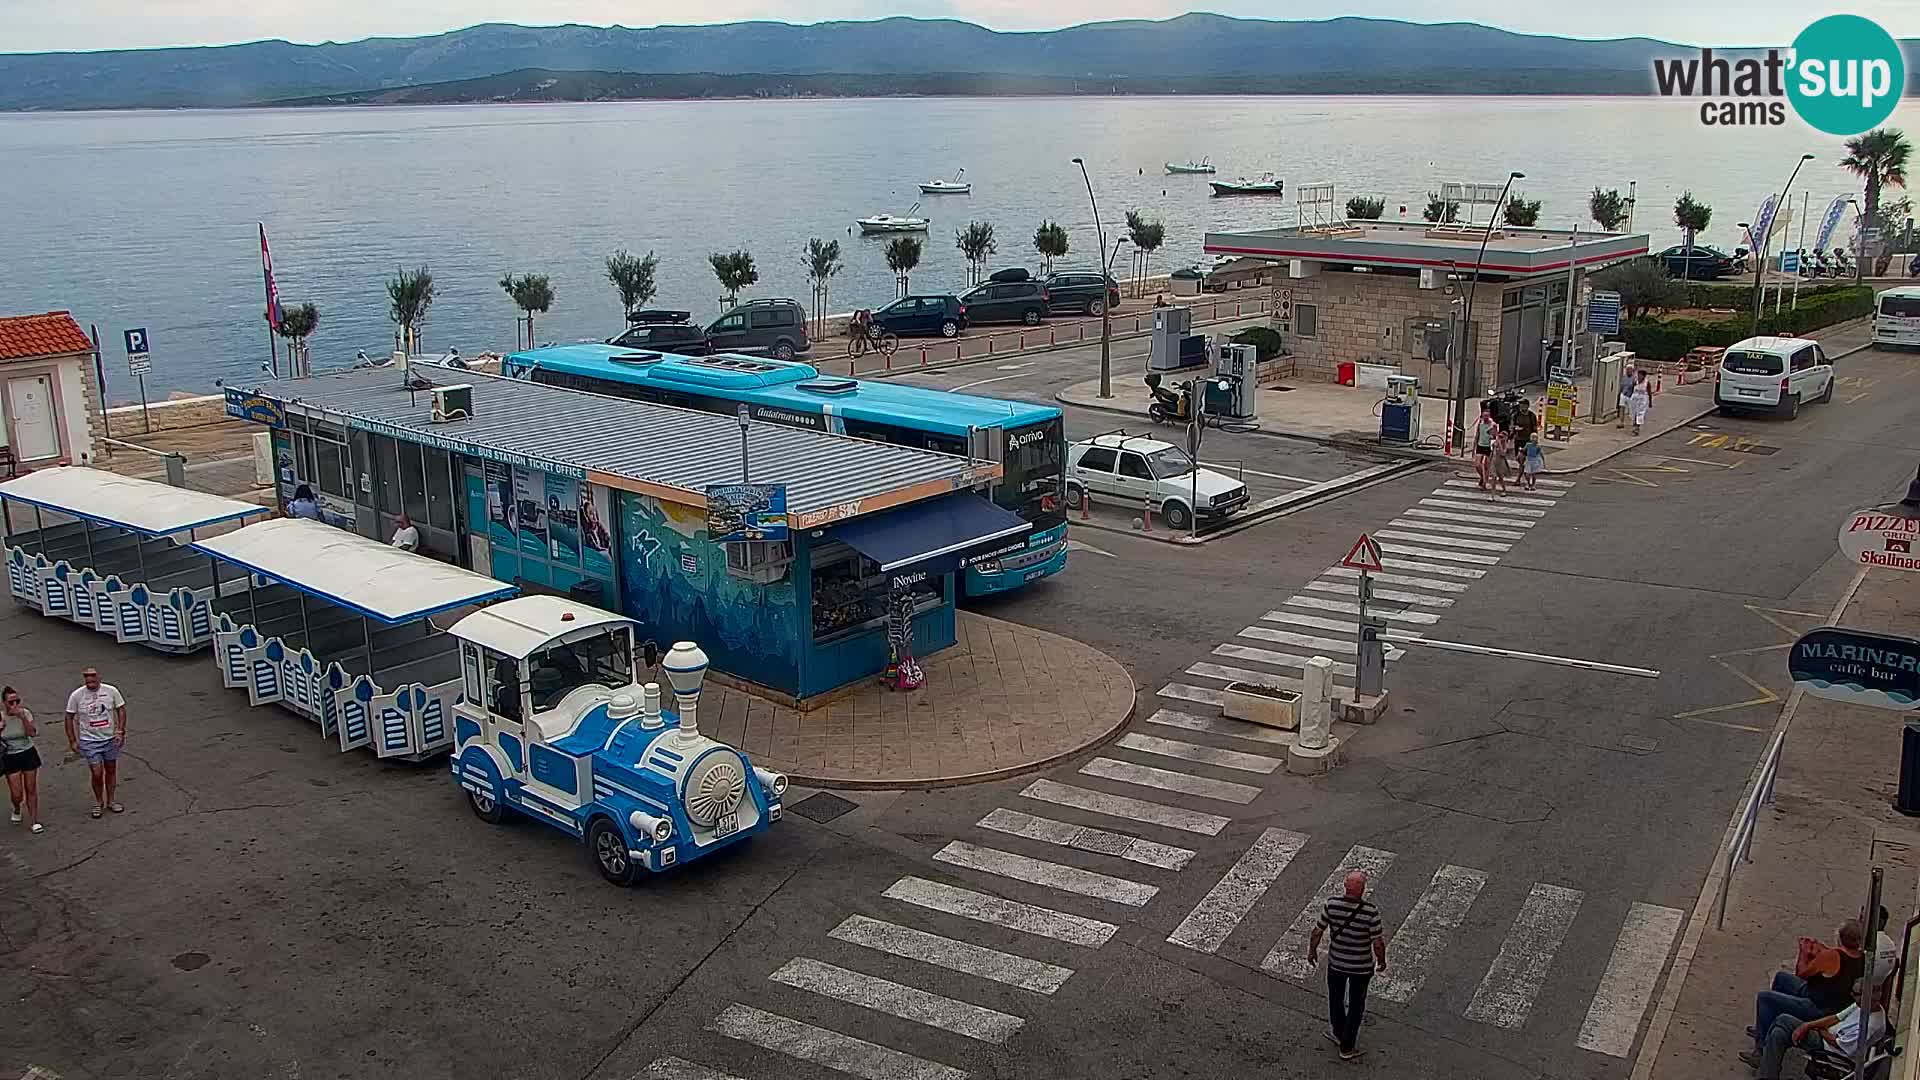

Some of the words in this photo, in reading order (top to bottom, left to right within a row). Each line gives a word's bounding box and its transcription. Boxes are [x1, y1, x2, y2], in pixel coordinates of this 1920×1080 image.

[130, 331, 143, 350] P
[1746, 352, 1763, 360] TAXI
[437, 436, 468, 452] POSTAJA
[479, 446, 493, 459] BUS
[494, 450, 526, 466] STATION
[528, 457, 554, 473] TICKET
[556, 465, 583, 478] OFFICE
[1848, 516, 1920, 534] PIZZE
[1882, 531, 1917, 541] GRILL
[1801, 643, 1920, 674] MARINER
[1871, 666, 1897, 681] bar
